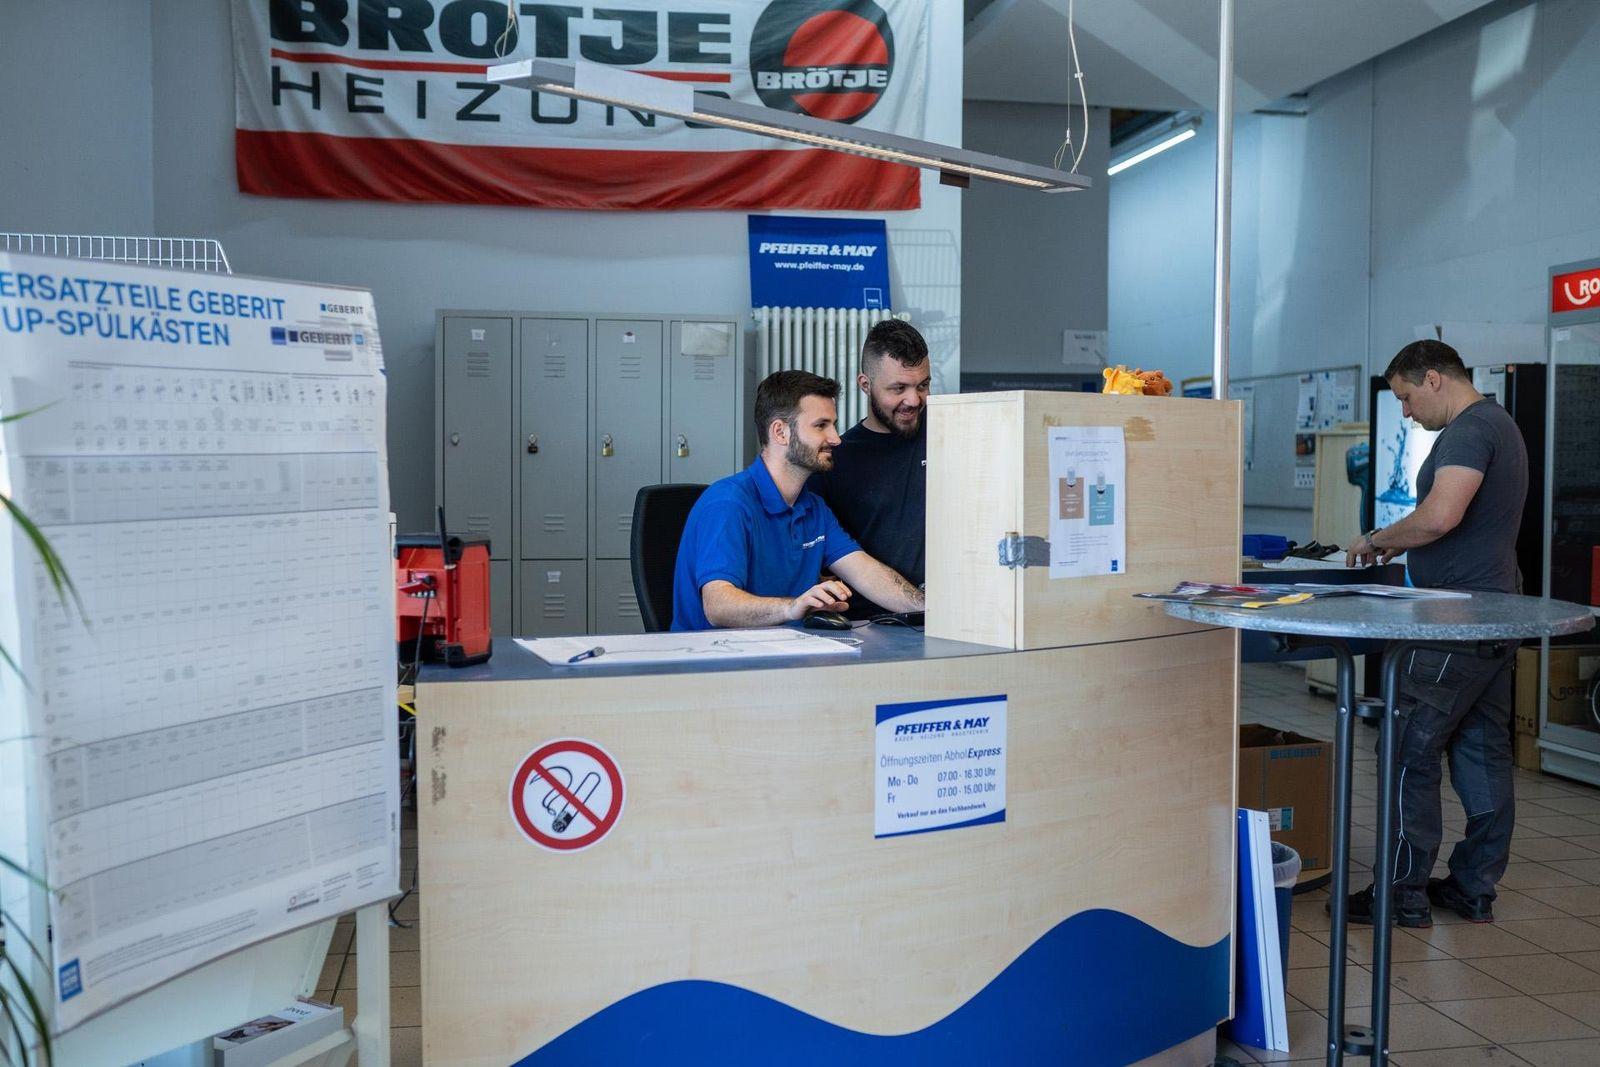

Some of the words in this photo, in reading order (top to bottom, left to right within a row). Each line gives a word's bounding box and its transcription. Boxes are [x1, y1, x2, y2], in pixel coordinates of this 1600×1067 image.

[757, 67, 888, 89] BRÖTJE
[271, 66, 731, 129] HEIZU
[759, 242, 829, 256] PFEIFFER
[829, 244, 842, 256] &
[842, 245, 877, 257] MAY
[774, 261, 865, 272] www.pfeiffer-may.de
[0, 272, 182, 312] ERSATZTEILE
[188, 289, 286, 320] GEBERIT
[327, 304, 364, 315] GEBERIT
[2, 306, 230, 346] UP-SPÜLKÄSTEN
[300, 331, 353, 345] GEBERIT
[895, 721, 952, 736] PFEIFFER
[953, 720, 961, 730] &
[963, 717, 990, 729] MAY
[880, 752, 943, 768] Öffnungszeiten
[888, 776, 901, 787] Mo
[907, 774, 918, 786] Do
[937, 770, 958, 782] 07.00
[984, 767, 996, 777] Uhr
[887, 792, 896, 804] Fr
[937, 786, 958, 798] 07.00
[984, 783, 996, 793] Uhr
[897, 810, 919, 819] Verkauf
